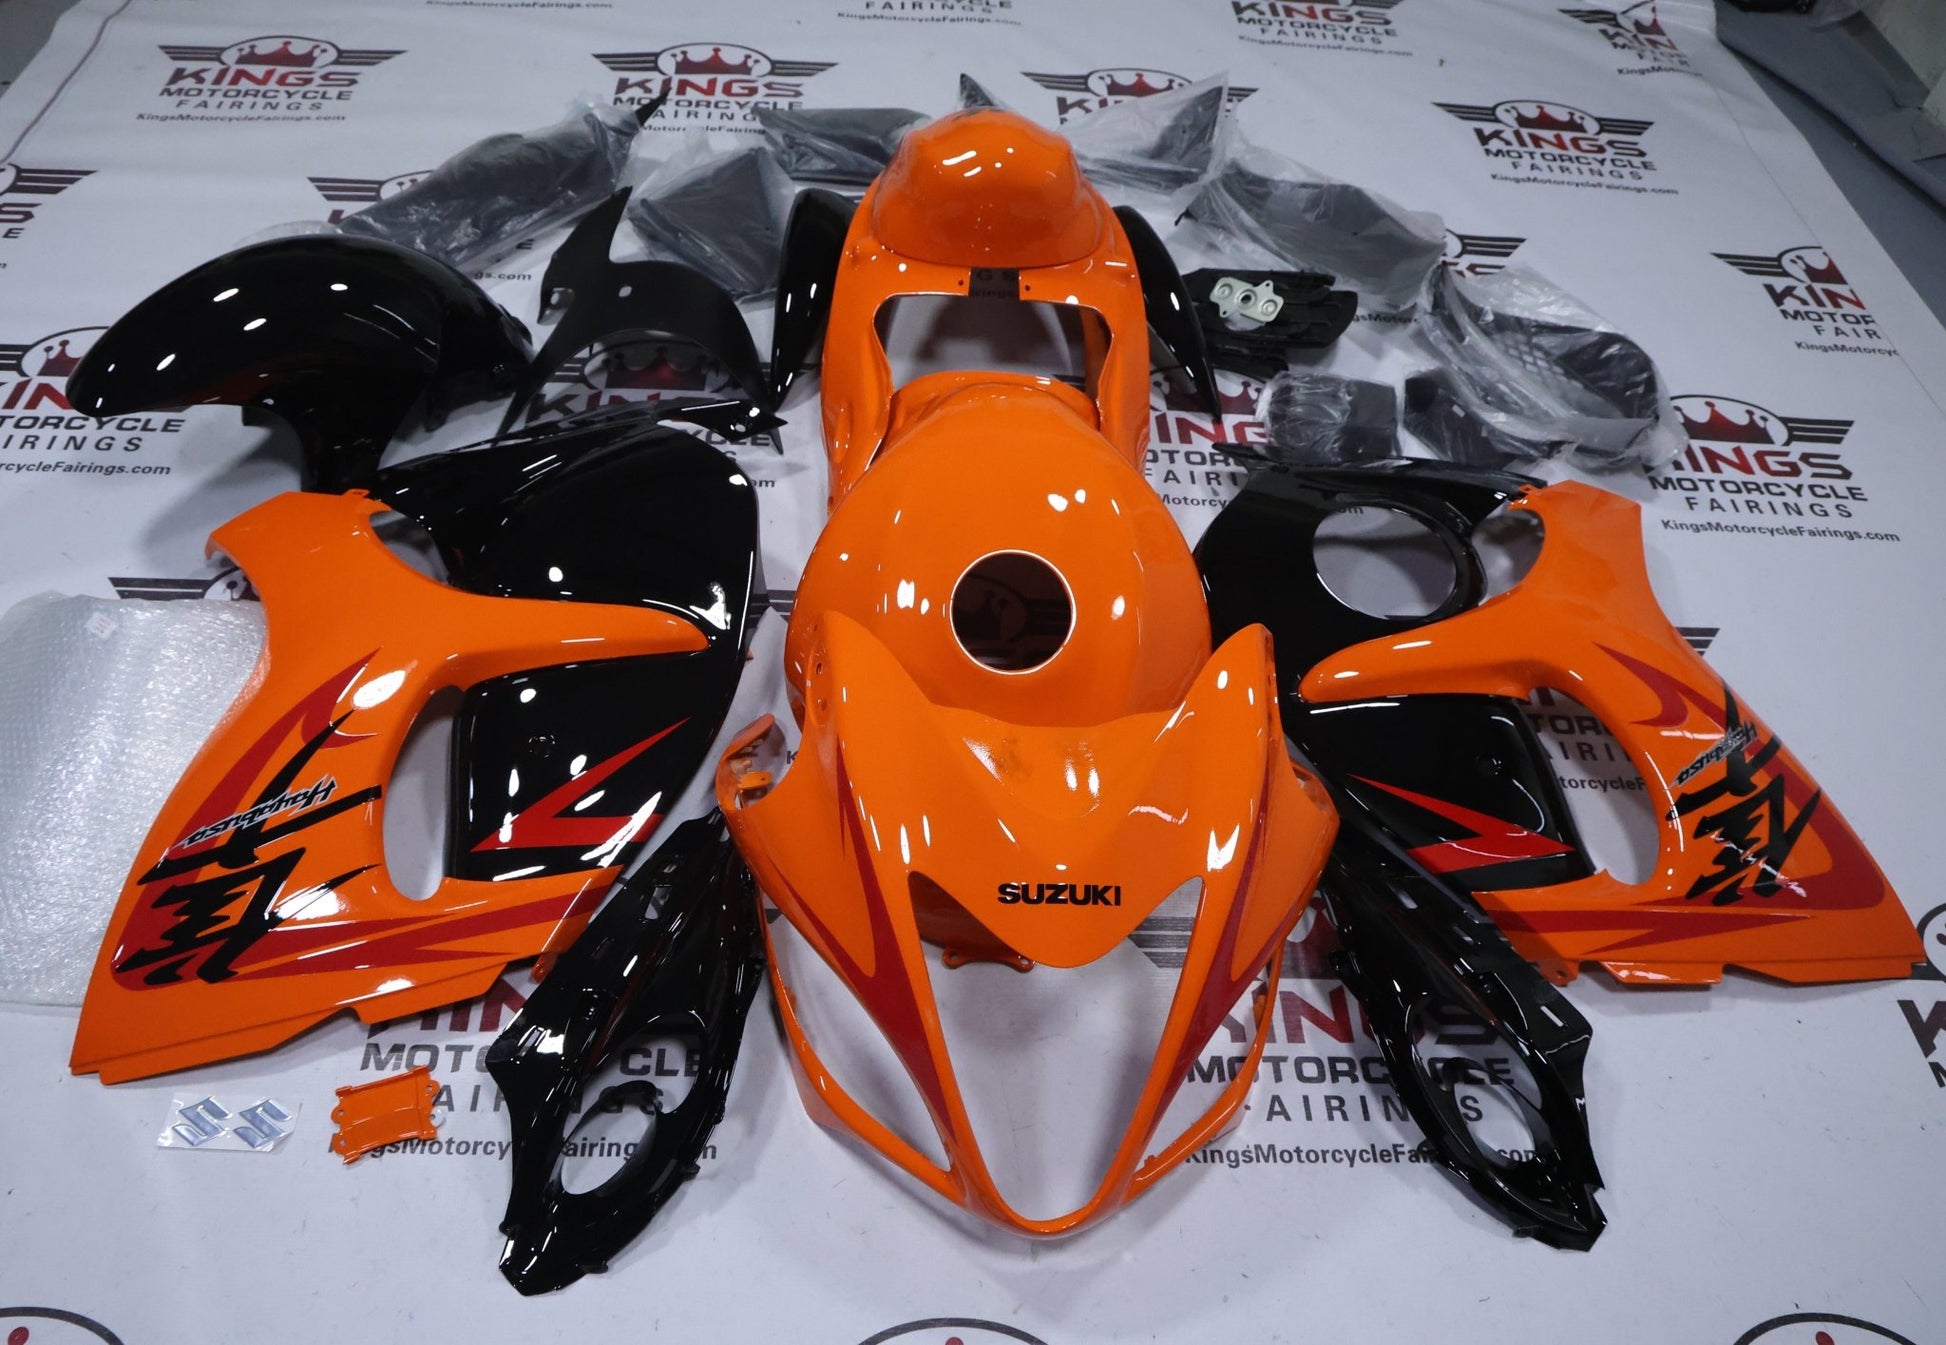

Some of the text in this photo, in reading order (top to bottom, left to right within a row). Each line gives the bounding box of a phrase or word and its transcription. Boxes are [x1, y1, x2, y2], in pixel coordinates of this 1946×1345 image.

[1231, 1, 1393, 26] KINGS
[1237, 16, 1398, 37] MOTORCYCLE
[1260, 27, 1382, 45] FAIRINGS
[165, 66, 363, 88] KINGS
[614, 76, 804, 98] KINGS
[159, 87, 354, 100] MOTORCYCLE
[176, 99, 324, 111] FAIRINGS
[136, 113, 346, 122] KingsMotorcycleFairings.com
[1473, 127, 1648, 158] KINGS
[1484, 148, 1658, 171] MOTORCYCLE
[1511, 161, 1643, 180] FAIRINGS
[1490, 173, 1679, 195] KingsMotorcycleFairings.com
[1642, 443, 1853, 481] INGS
[1648, 476, 1869, 502] MOTORCYCLE
[1685, 496, 1853, 518] FAIRINGS
[1660, 518, 1900, 543] KingsMotorcycleFairings.com
[998, 882, 1122, 907] SUZUKI
